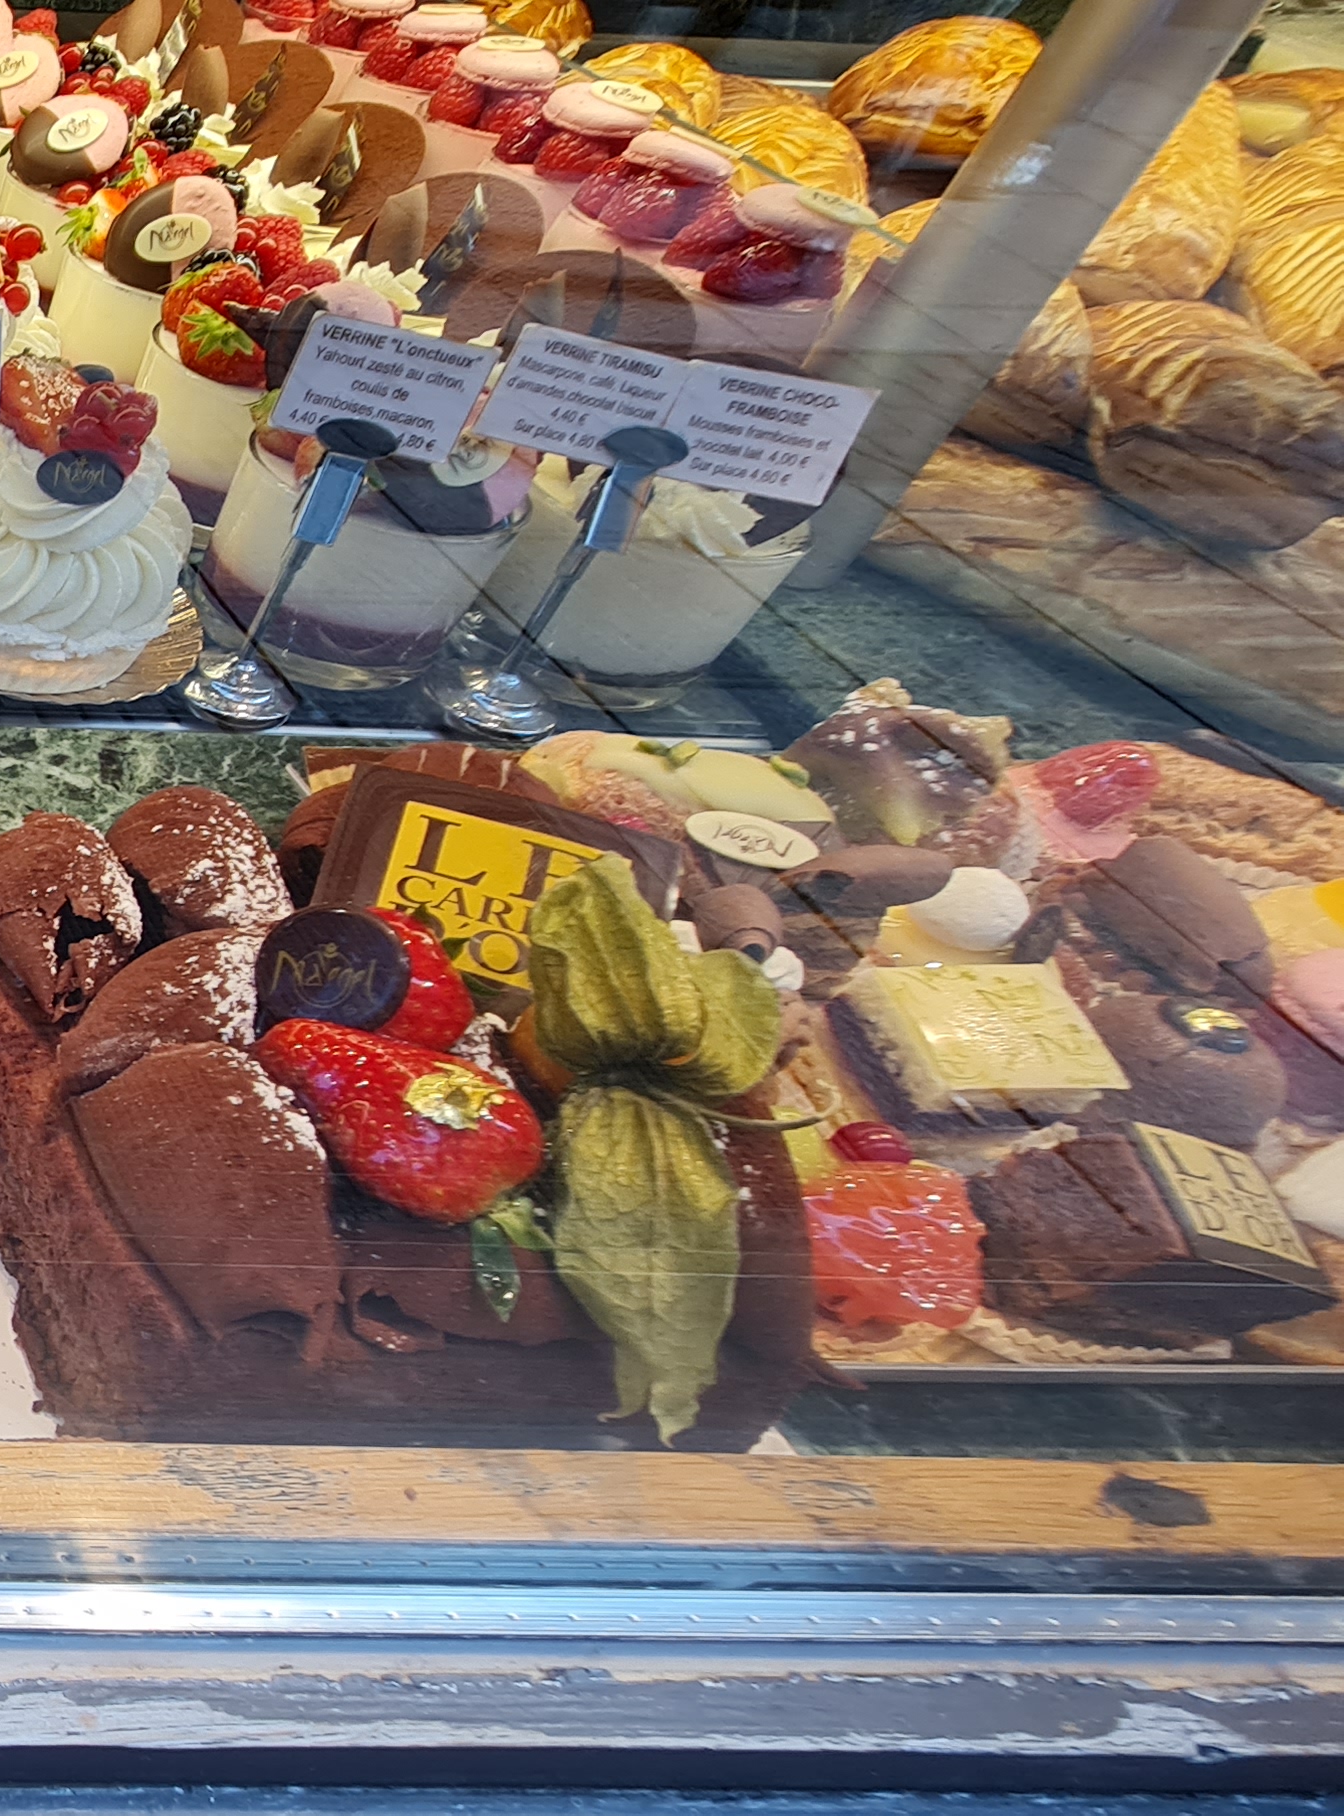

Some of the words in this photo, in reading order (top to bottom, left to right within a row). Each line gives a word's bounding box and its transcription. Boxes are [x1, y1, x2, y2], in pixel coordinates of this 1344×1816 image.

[322, 323, 388, 350] VERRINE
[544, 339, 599, 364] VERRINE
[601, 352, 664, 378] TIRAMISU
[367, 360, 404, 377] zesté
[406, 368, 424, 381] au
[425, 370, 466, 392] citron,
[350, 378, 390, 398] coulis
[392, 388, 410, 402] de
[719, 376, 782, 400] VERRINE
[783, 388, 840, 409] CHOCO-
[579, 413, 590, 426] €
[726, 400, 814, 426] FRAMBOISE
[289, 409, 317, 425] 4,40
[426, 438, 437, 452] €
[514, 418, 535, 434] Sur
[534, 424, 564, 442] place
[815, 439, 832, 453] et
[689, 457, 712, 472] Sur
[712, 463, 749, 478] place
[780, 473, 793, 485] €
[799, 456, 811, 469] €
